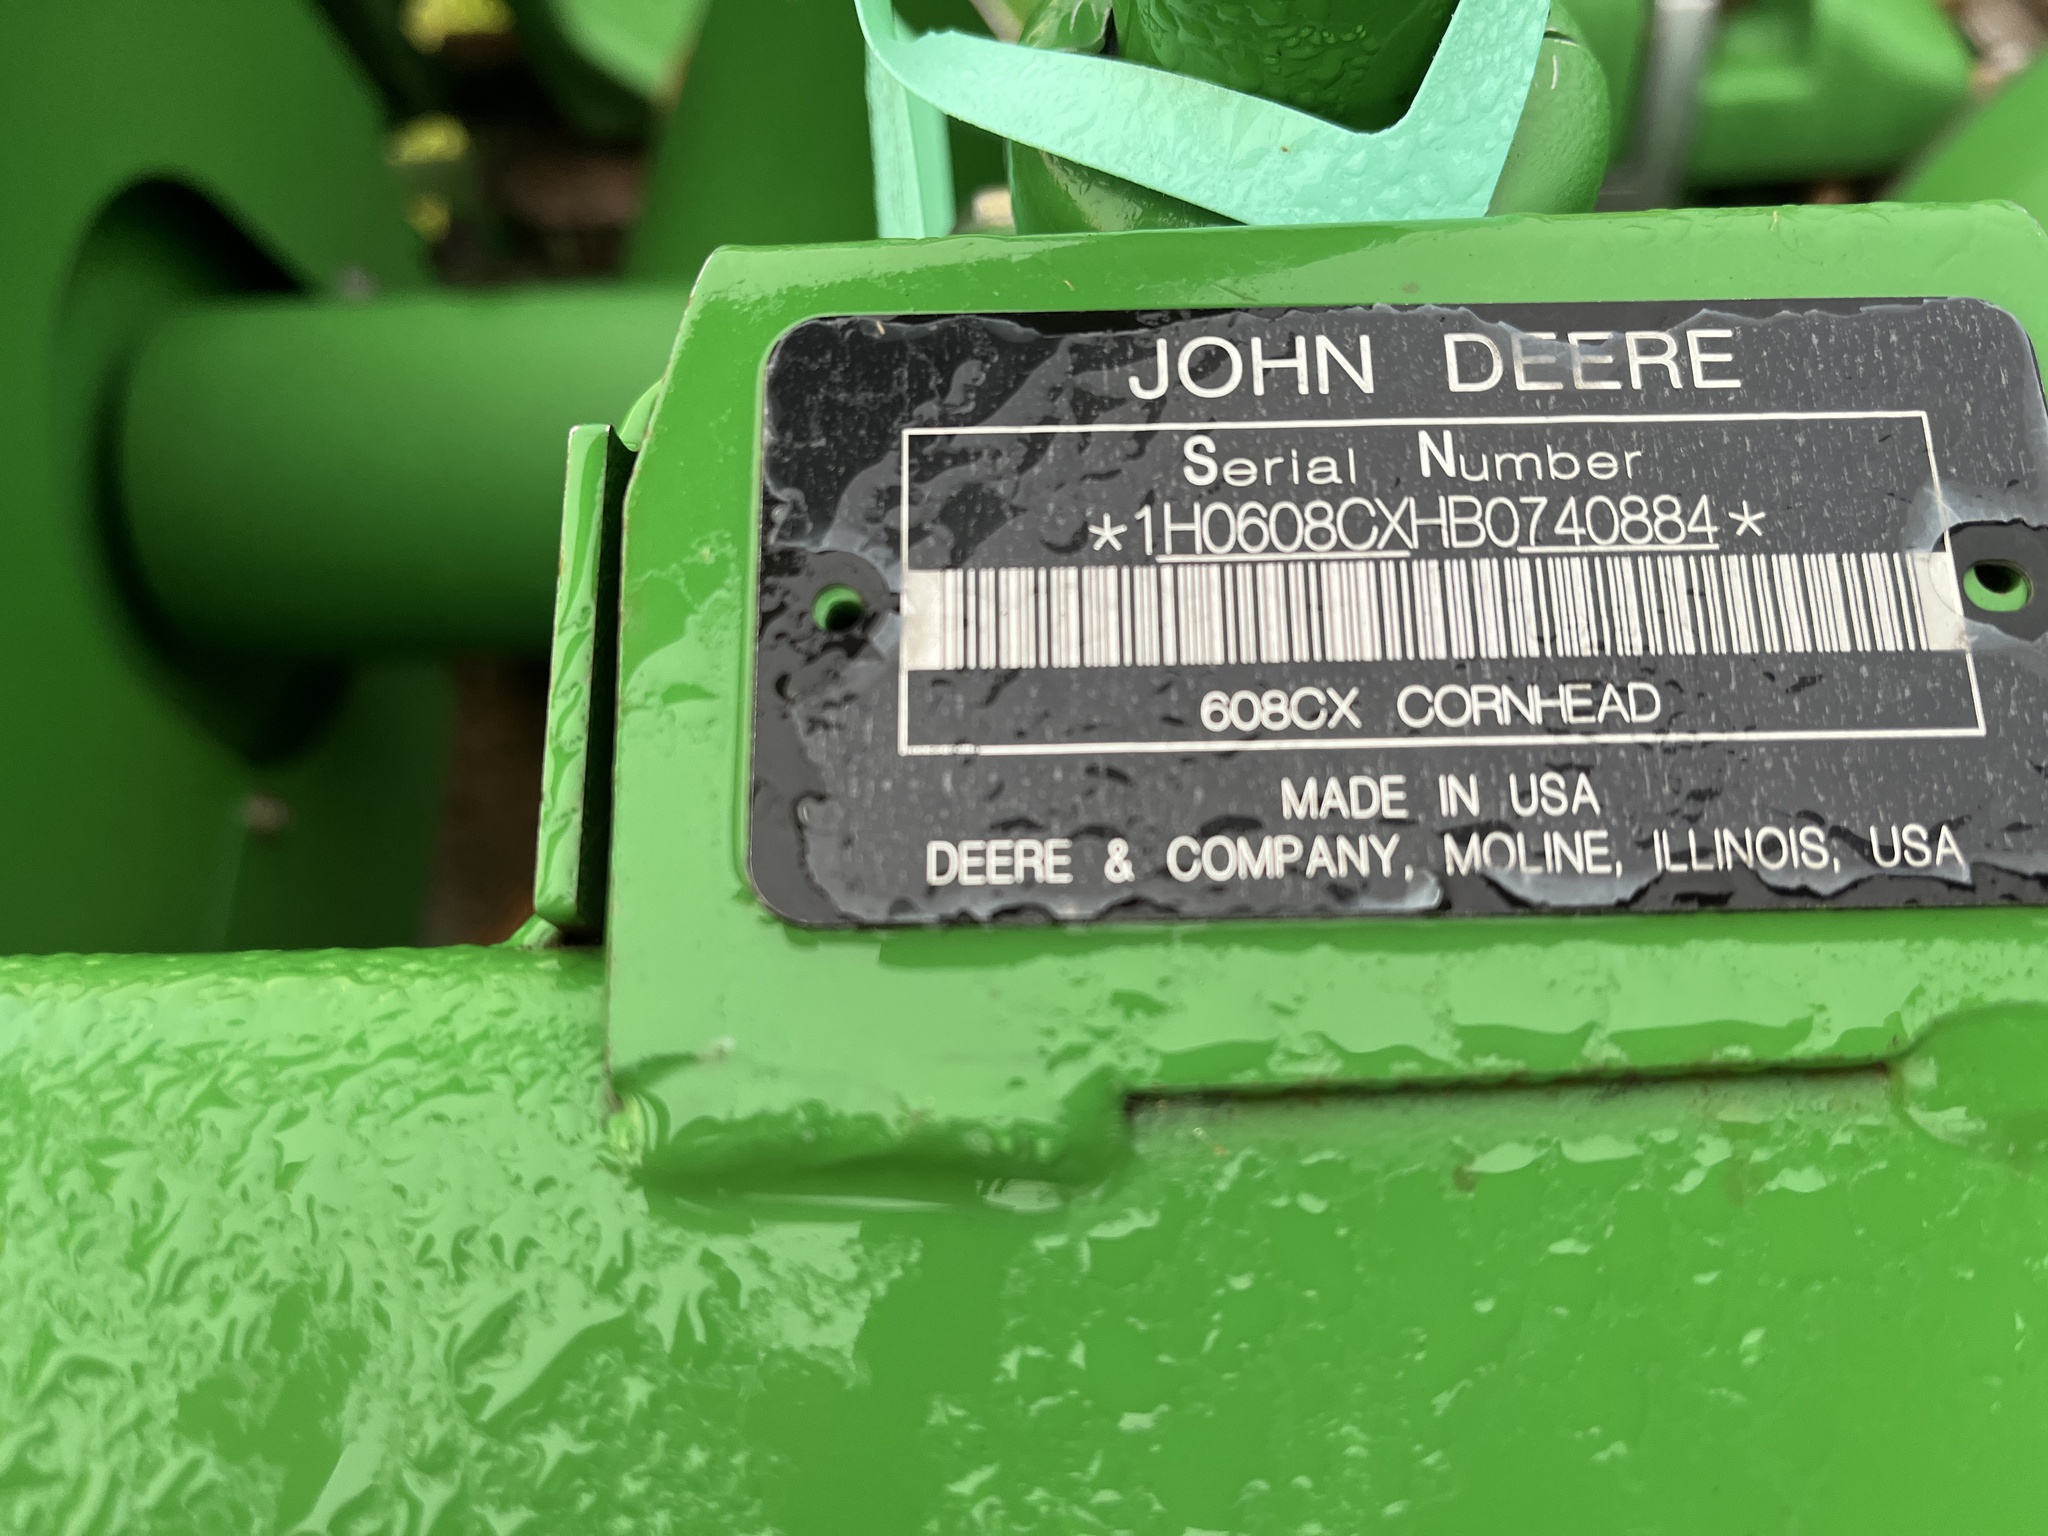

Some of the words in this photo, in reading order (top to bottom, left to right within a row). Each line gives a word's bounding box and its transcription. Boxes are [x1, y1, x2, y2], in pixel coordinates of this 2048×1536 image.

[1128, 334, 1375, 400] JOHN
[1444, 329, 1741, 393] DEERE
[1183, 434, 1358, 487] Serial
[1418, 430, 1643, 483] Number
[1200, 686, 1363, 732] 608CX
[1397, 681, 1661, 728] CORNHEAD
[1281, 775, 1409, 820] MADE
[1438, 773, 1480, 818] IN
[1509, 771, 1601, 818] USA
[926, 838, 1074, 886] DEERE
[1104, 837, 1135, 883] &
[1166, 833, 1414, 883] COMPANY,
[1443, 829, 1623, 878] MOLINE,
[1652, 824, 1842, 872] ILLINOIS,
[1869, 823, 1966, 869] USA
